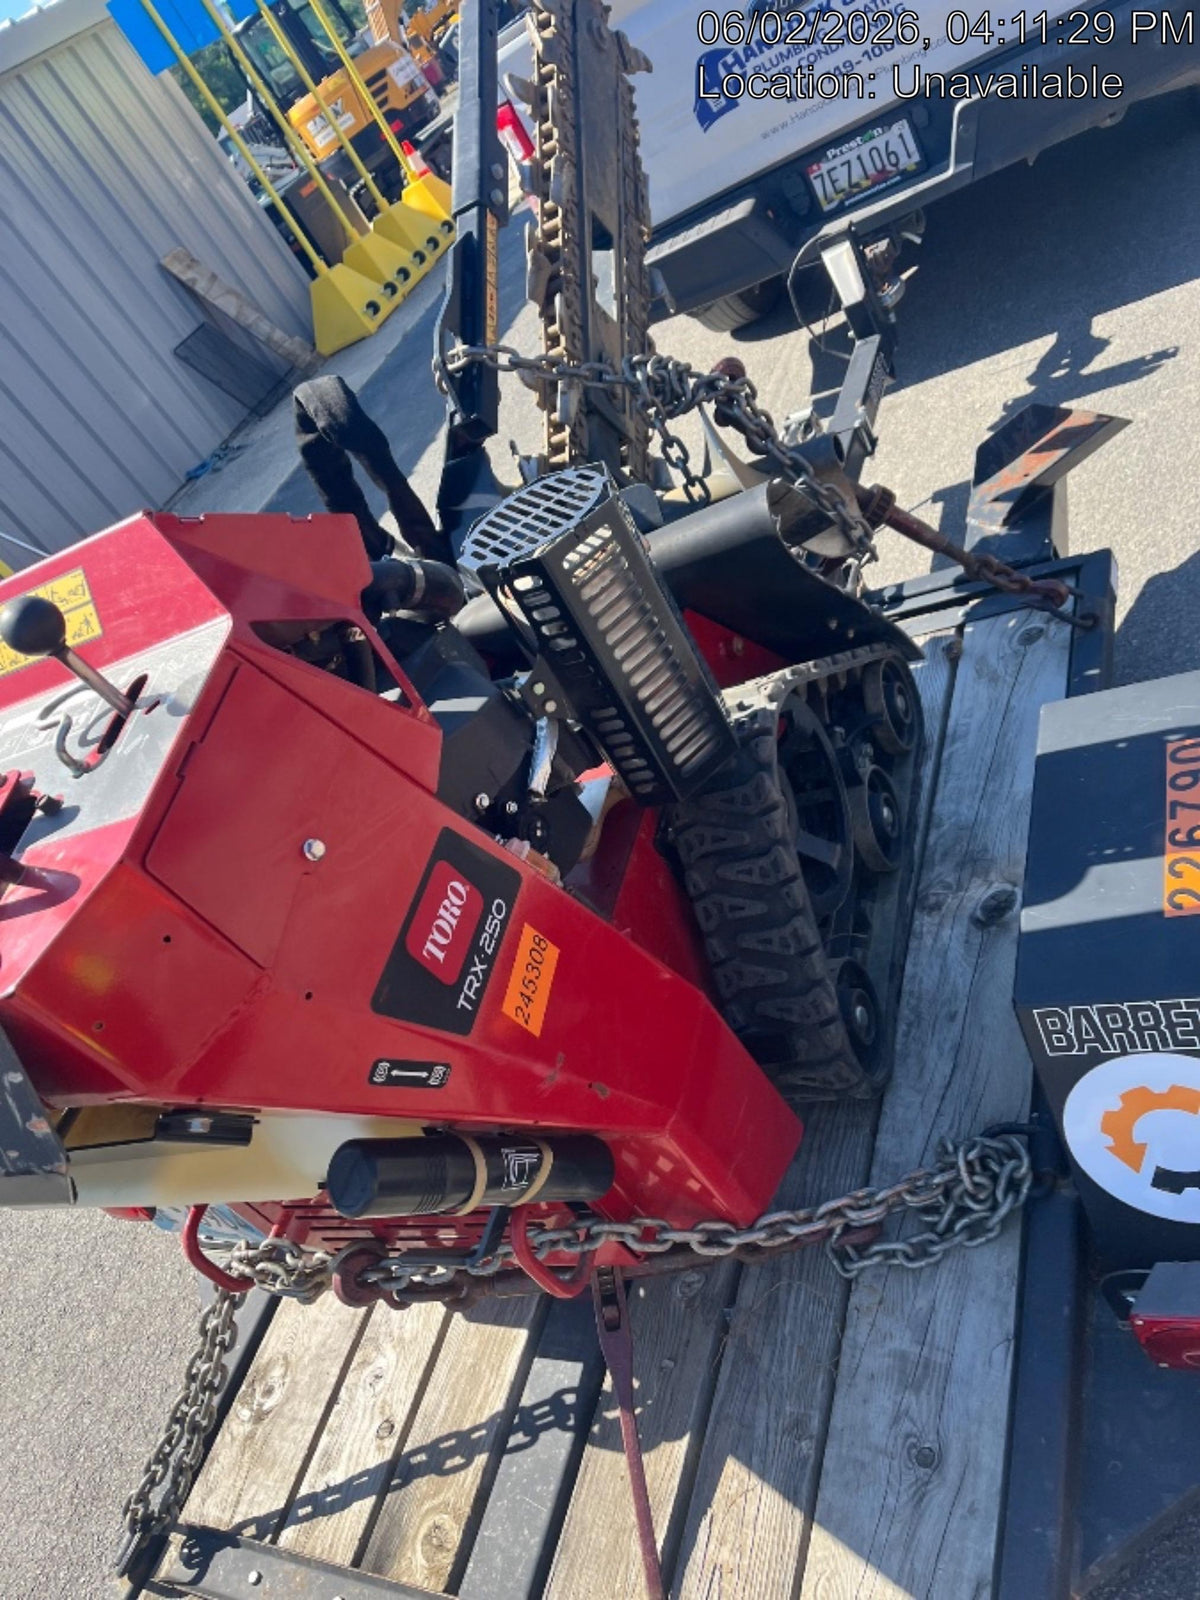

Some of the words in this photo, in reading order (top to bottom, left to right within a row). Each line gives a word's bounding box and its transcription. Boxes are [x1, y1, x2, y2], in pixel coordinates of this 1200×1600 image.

[813, 132, 912, 202] 7EZ1061
[423, 882, 468, 963] TORO
[515, 934, 549, 1026] 245308
